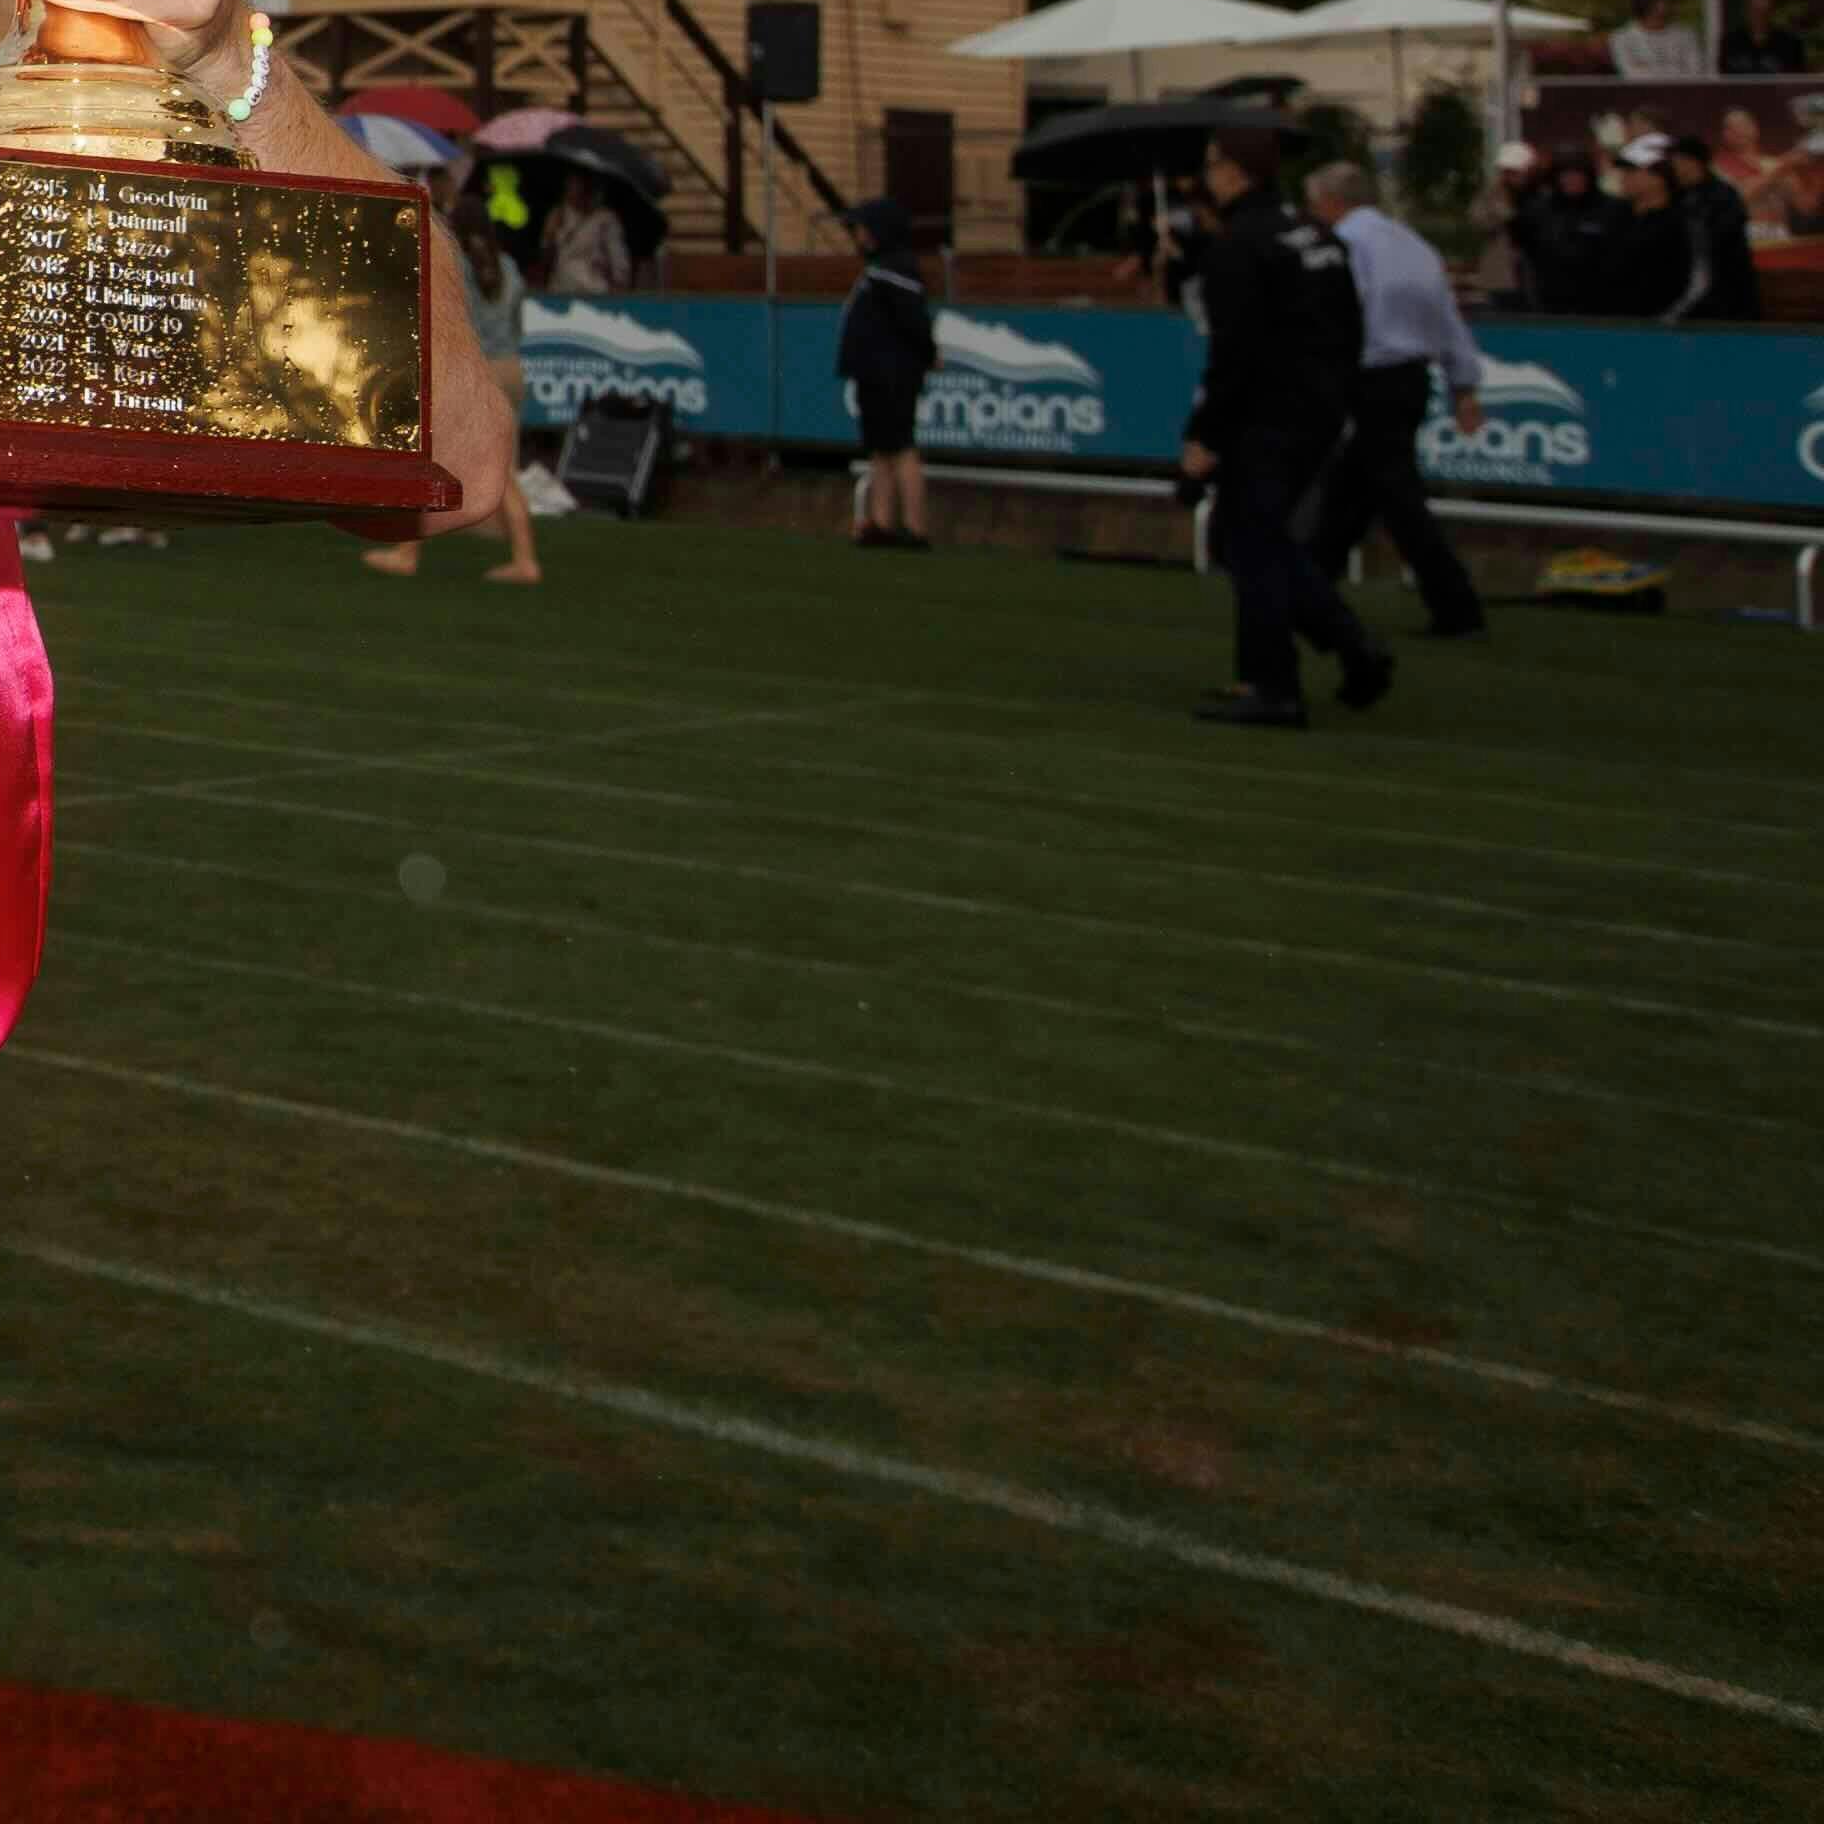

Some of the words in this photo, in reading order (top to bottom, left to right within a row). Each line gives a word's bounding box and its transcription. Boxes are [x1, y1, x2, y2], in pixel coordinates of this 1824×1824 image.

[22, 177, 68, 198] 2015
[119, 186, 208, 211] Goodwin
[84, 312, 154, 334] COVID
[160, 314, 183, 335] 19
